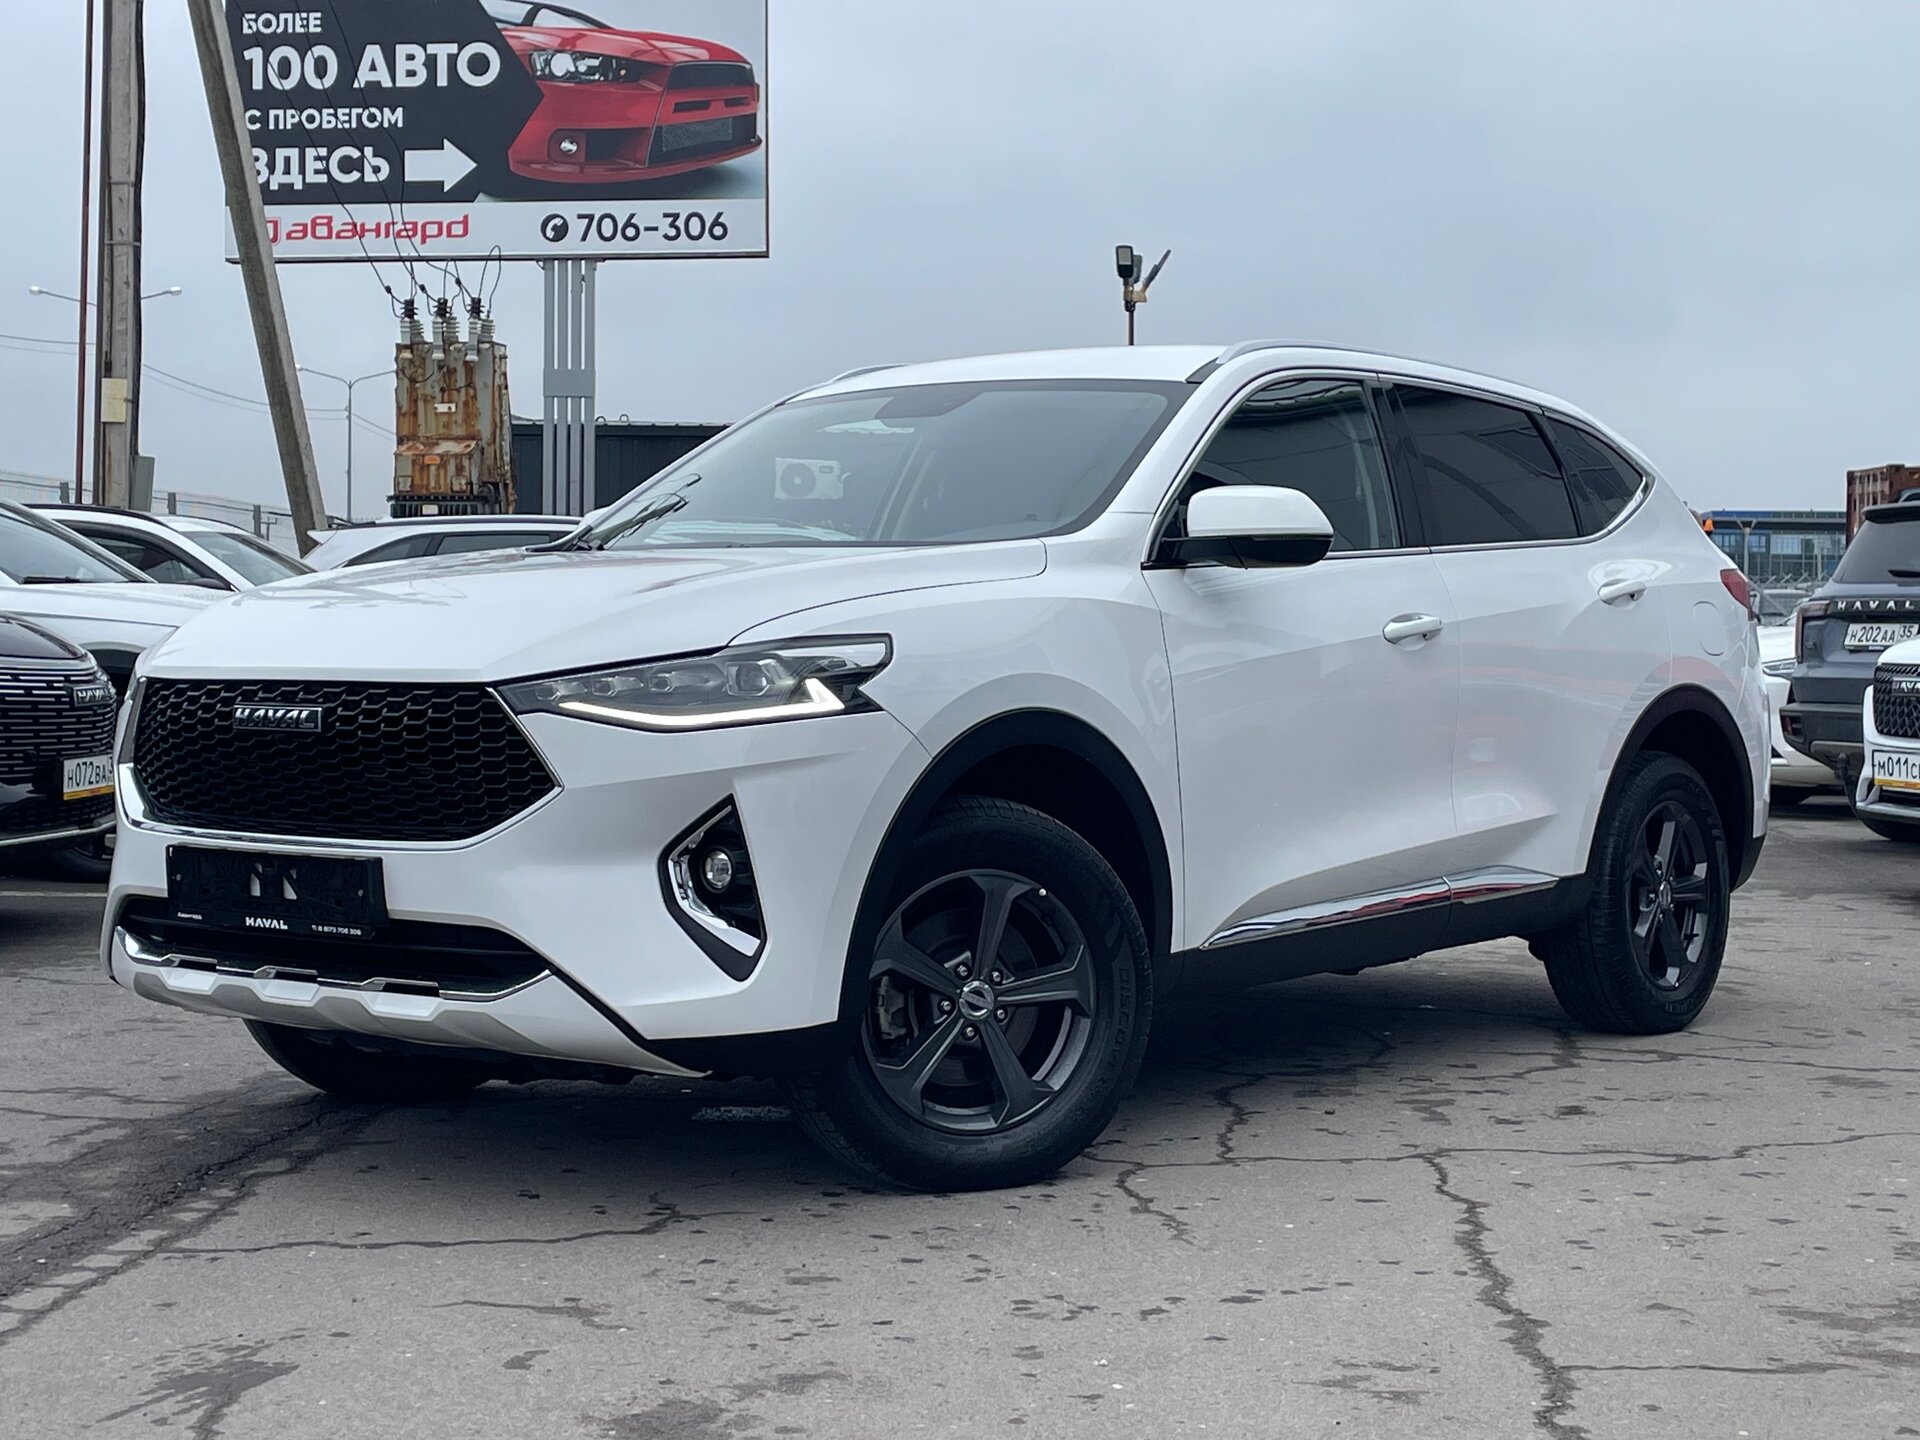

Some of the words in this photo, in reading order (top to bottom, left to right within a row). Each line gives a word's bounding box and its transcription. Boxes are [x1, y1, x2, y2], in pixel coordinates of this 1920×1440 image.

[242, 12, 322, 34] БОЛЕЕ
[243, 45, 338, 90] 100
[353, 42, 501, 88] АВТО
[245, 109, 262, 130] С
[268, 107, 404, 130] ПРОБЕГОМ
[251, 146, 390, 190] ЗДЕСЬ
[576, 212, 729, 242] 706-306
[1837, 600, 1915, 610] HAVAL
[1849, 626, 1896, 643] Н202АА
[1900, 625, 1914, 638] 35
[234, 708, 315, 728] HAVAL
[67, 760, 107, 788] Н072ВА
[1877, 756, 1920, 779] М011С
[245, 916, 288, 930] HAVAL
